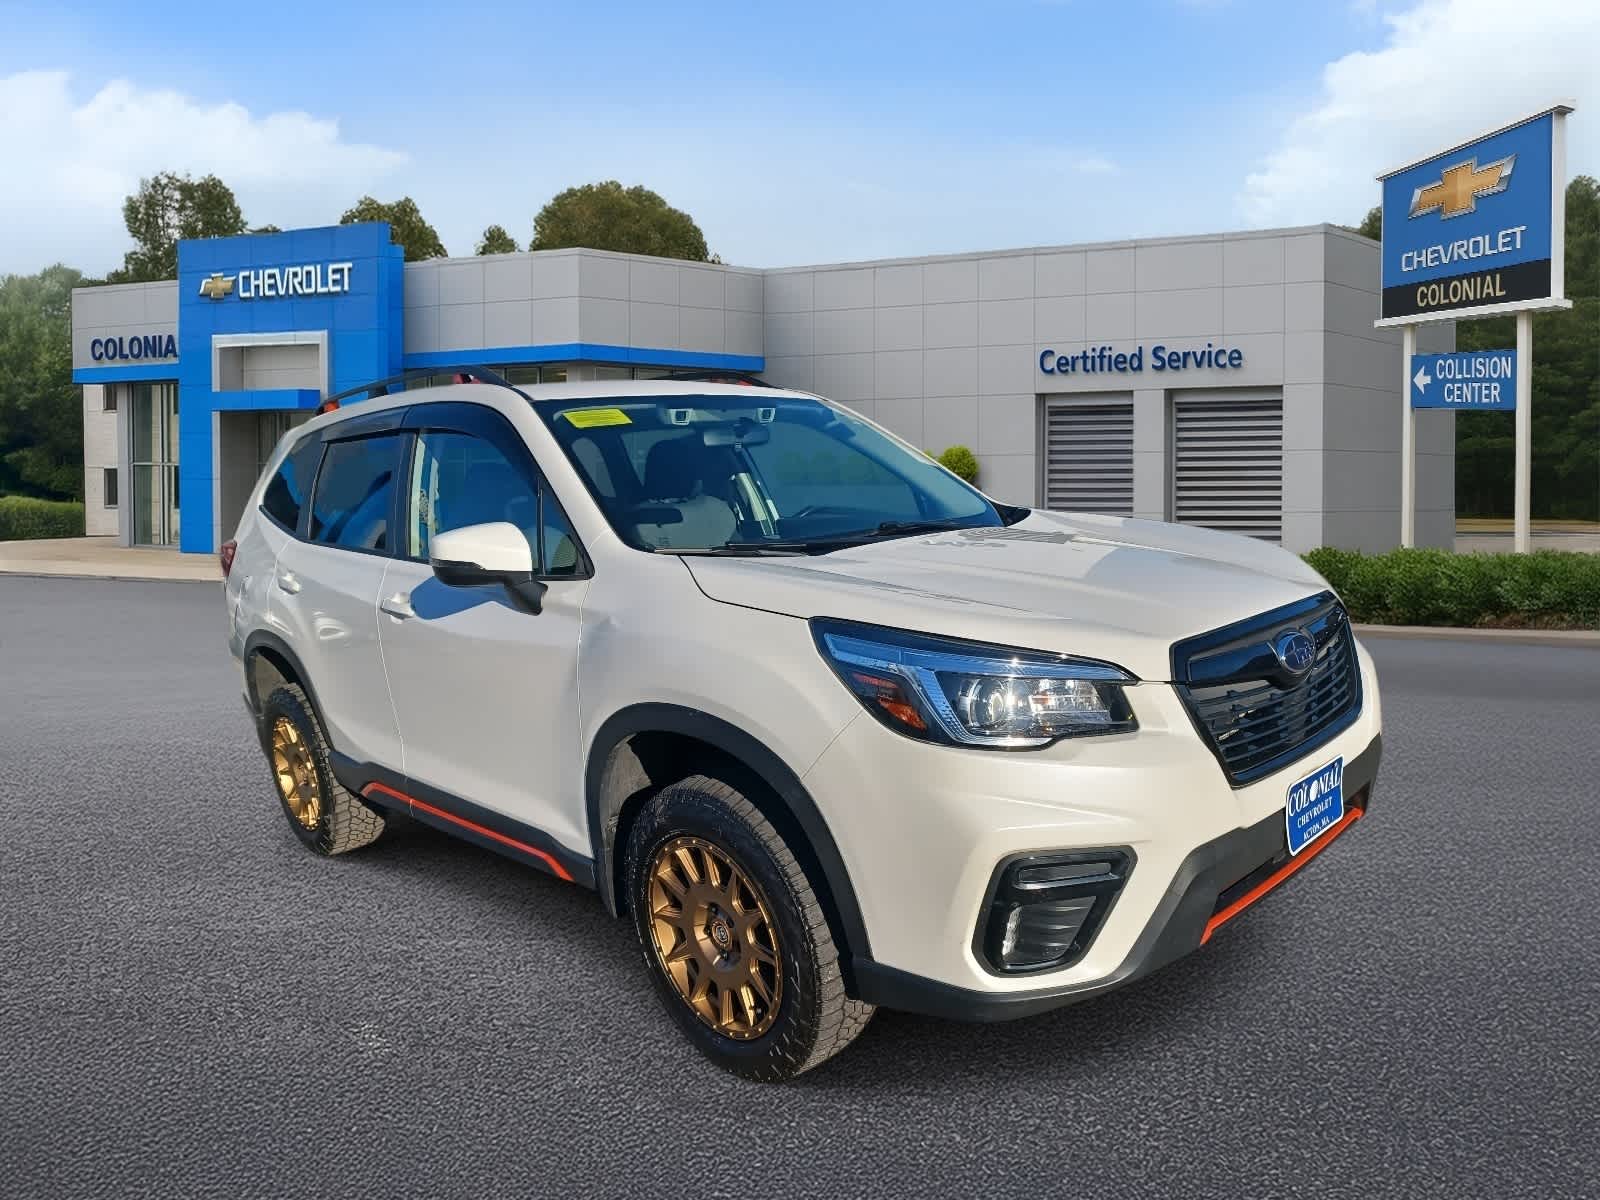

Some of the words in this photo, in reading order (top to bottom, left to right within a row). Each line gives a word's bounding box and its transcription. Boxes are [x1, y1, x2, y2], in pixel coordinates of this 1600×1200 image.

[1401, 226, 1527, 272] CHEVROLET
[238, 262, 353, 298] CHEVROLET
[1416, 273, 1506, 307] COLONIAL
[1039, 346, 1144, 375] Certified
[1151, 343, 1243, 371] Service
[1436, 356, 1512, 380] COLLISION
[1444, 382, 1501, 404] CENTER
[1288, 766, 1341, 817] COLONIAL
[1297, 797, 1333, 829] CHEVROLET
